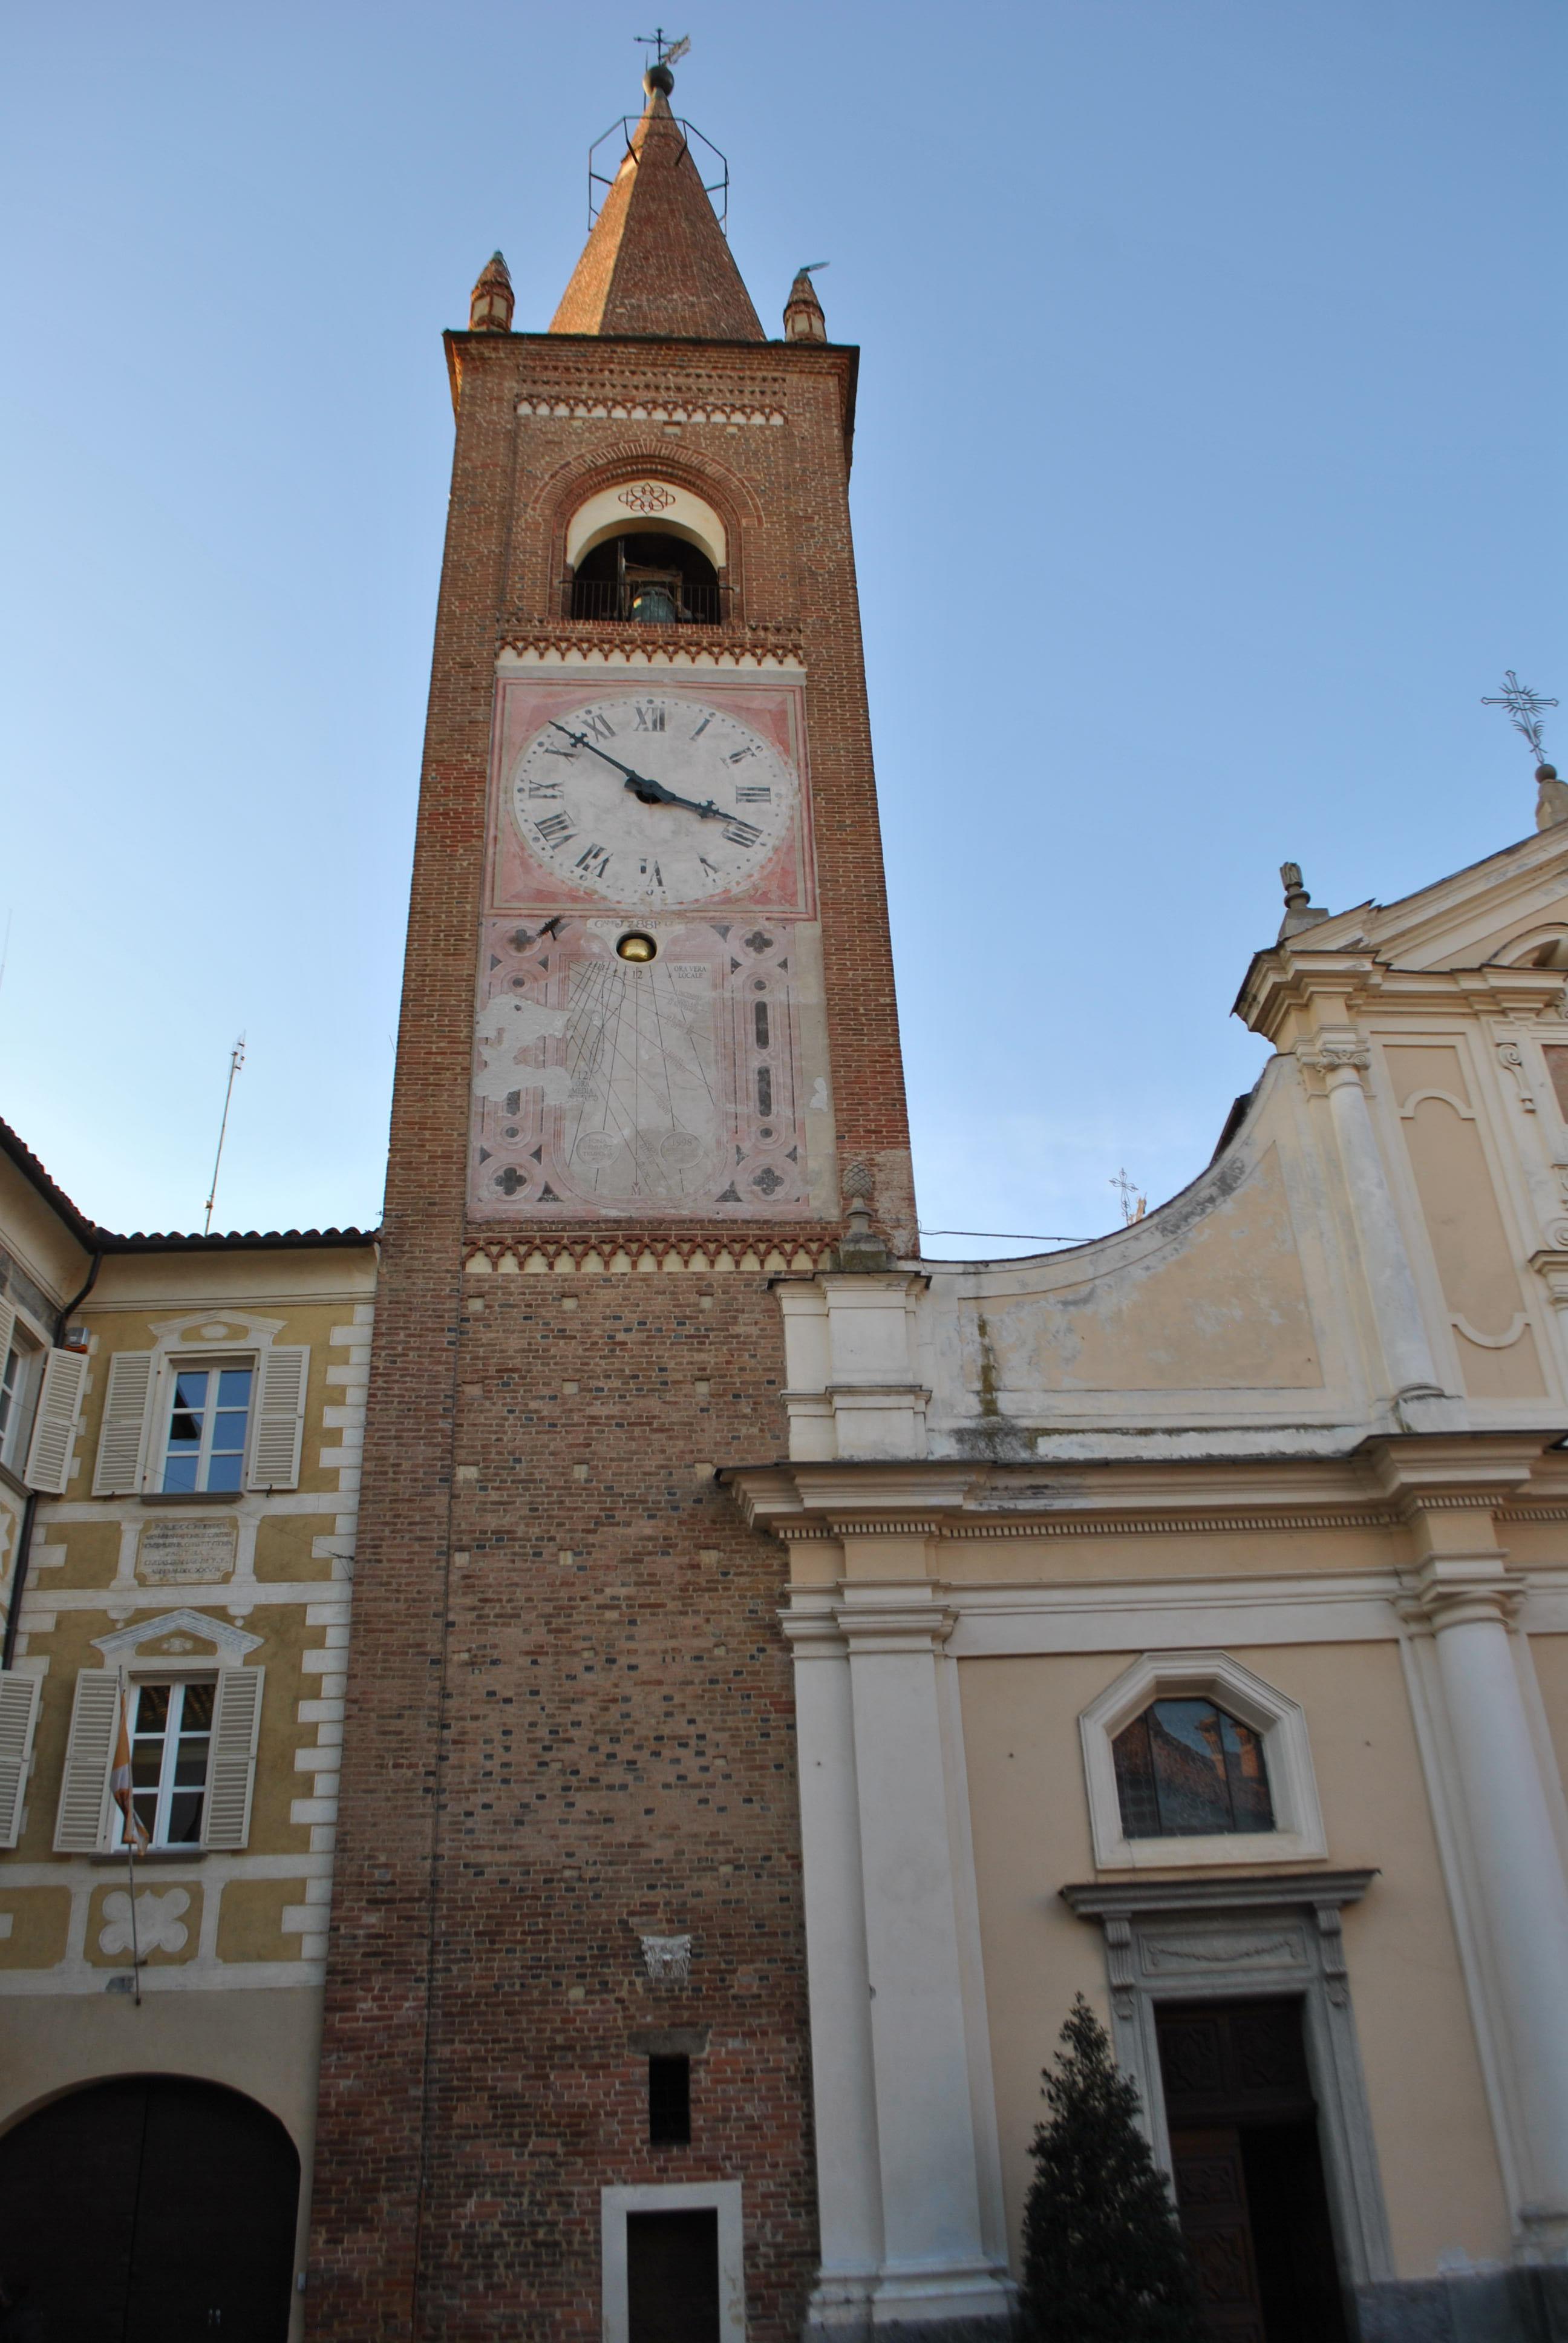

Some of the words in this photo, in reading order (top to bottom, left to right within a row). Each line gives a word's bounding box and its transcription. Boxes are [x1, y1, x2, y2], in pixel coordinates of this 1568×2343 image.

[582, 714, 617, 742] XI
[633, 706, 666, 732] XII
[544, 742, 580, 766] X
[529, 780, 564, 799] IX
[736, 786, 771, 804] III
[632, 970, 642, 979] 12
[578, 1070, 588, 1080] 12
[630, 1185, 642, 1196] M
